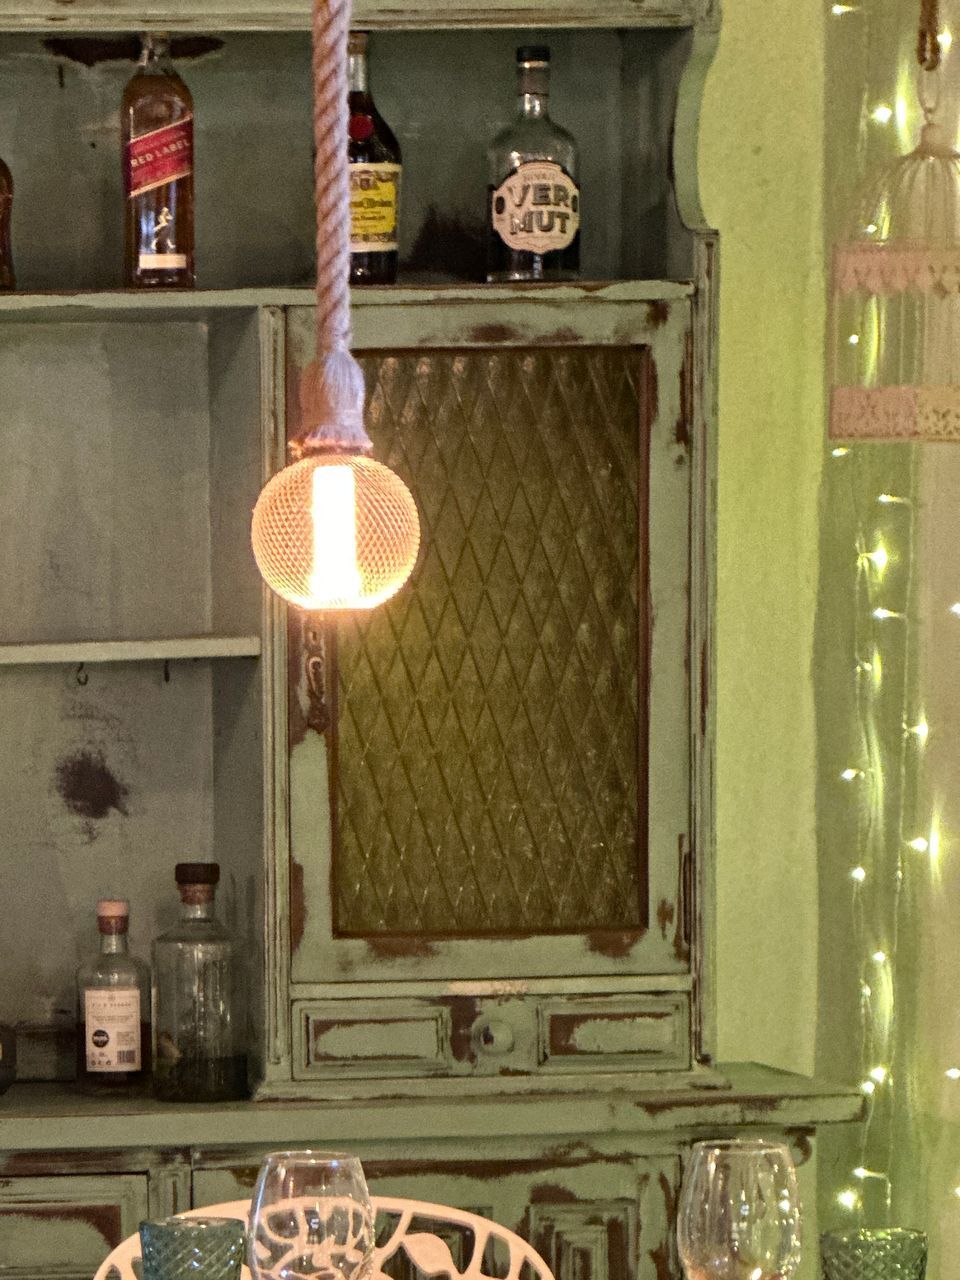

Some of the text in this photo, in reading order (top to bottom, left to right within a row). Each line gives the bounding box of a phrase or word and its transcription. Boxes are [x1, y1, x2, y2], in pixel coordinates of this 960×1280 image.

[130, 139, 191, 167] RED LABEL
[506, 184, 569, 208] VER
[509, 210, 570, 235] MUT
